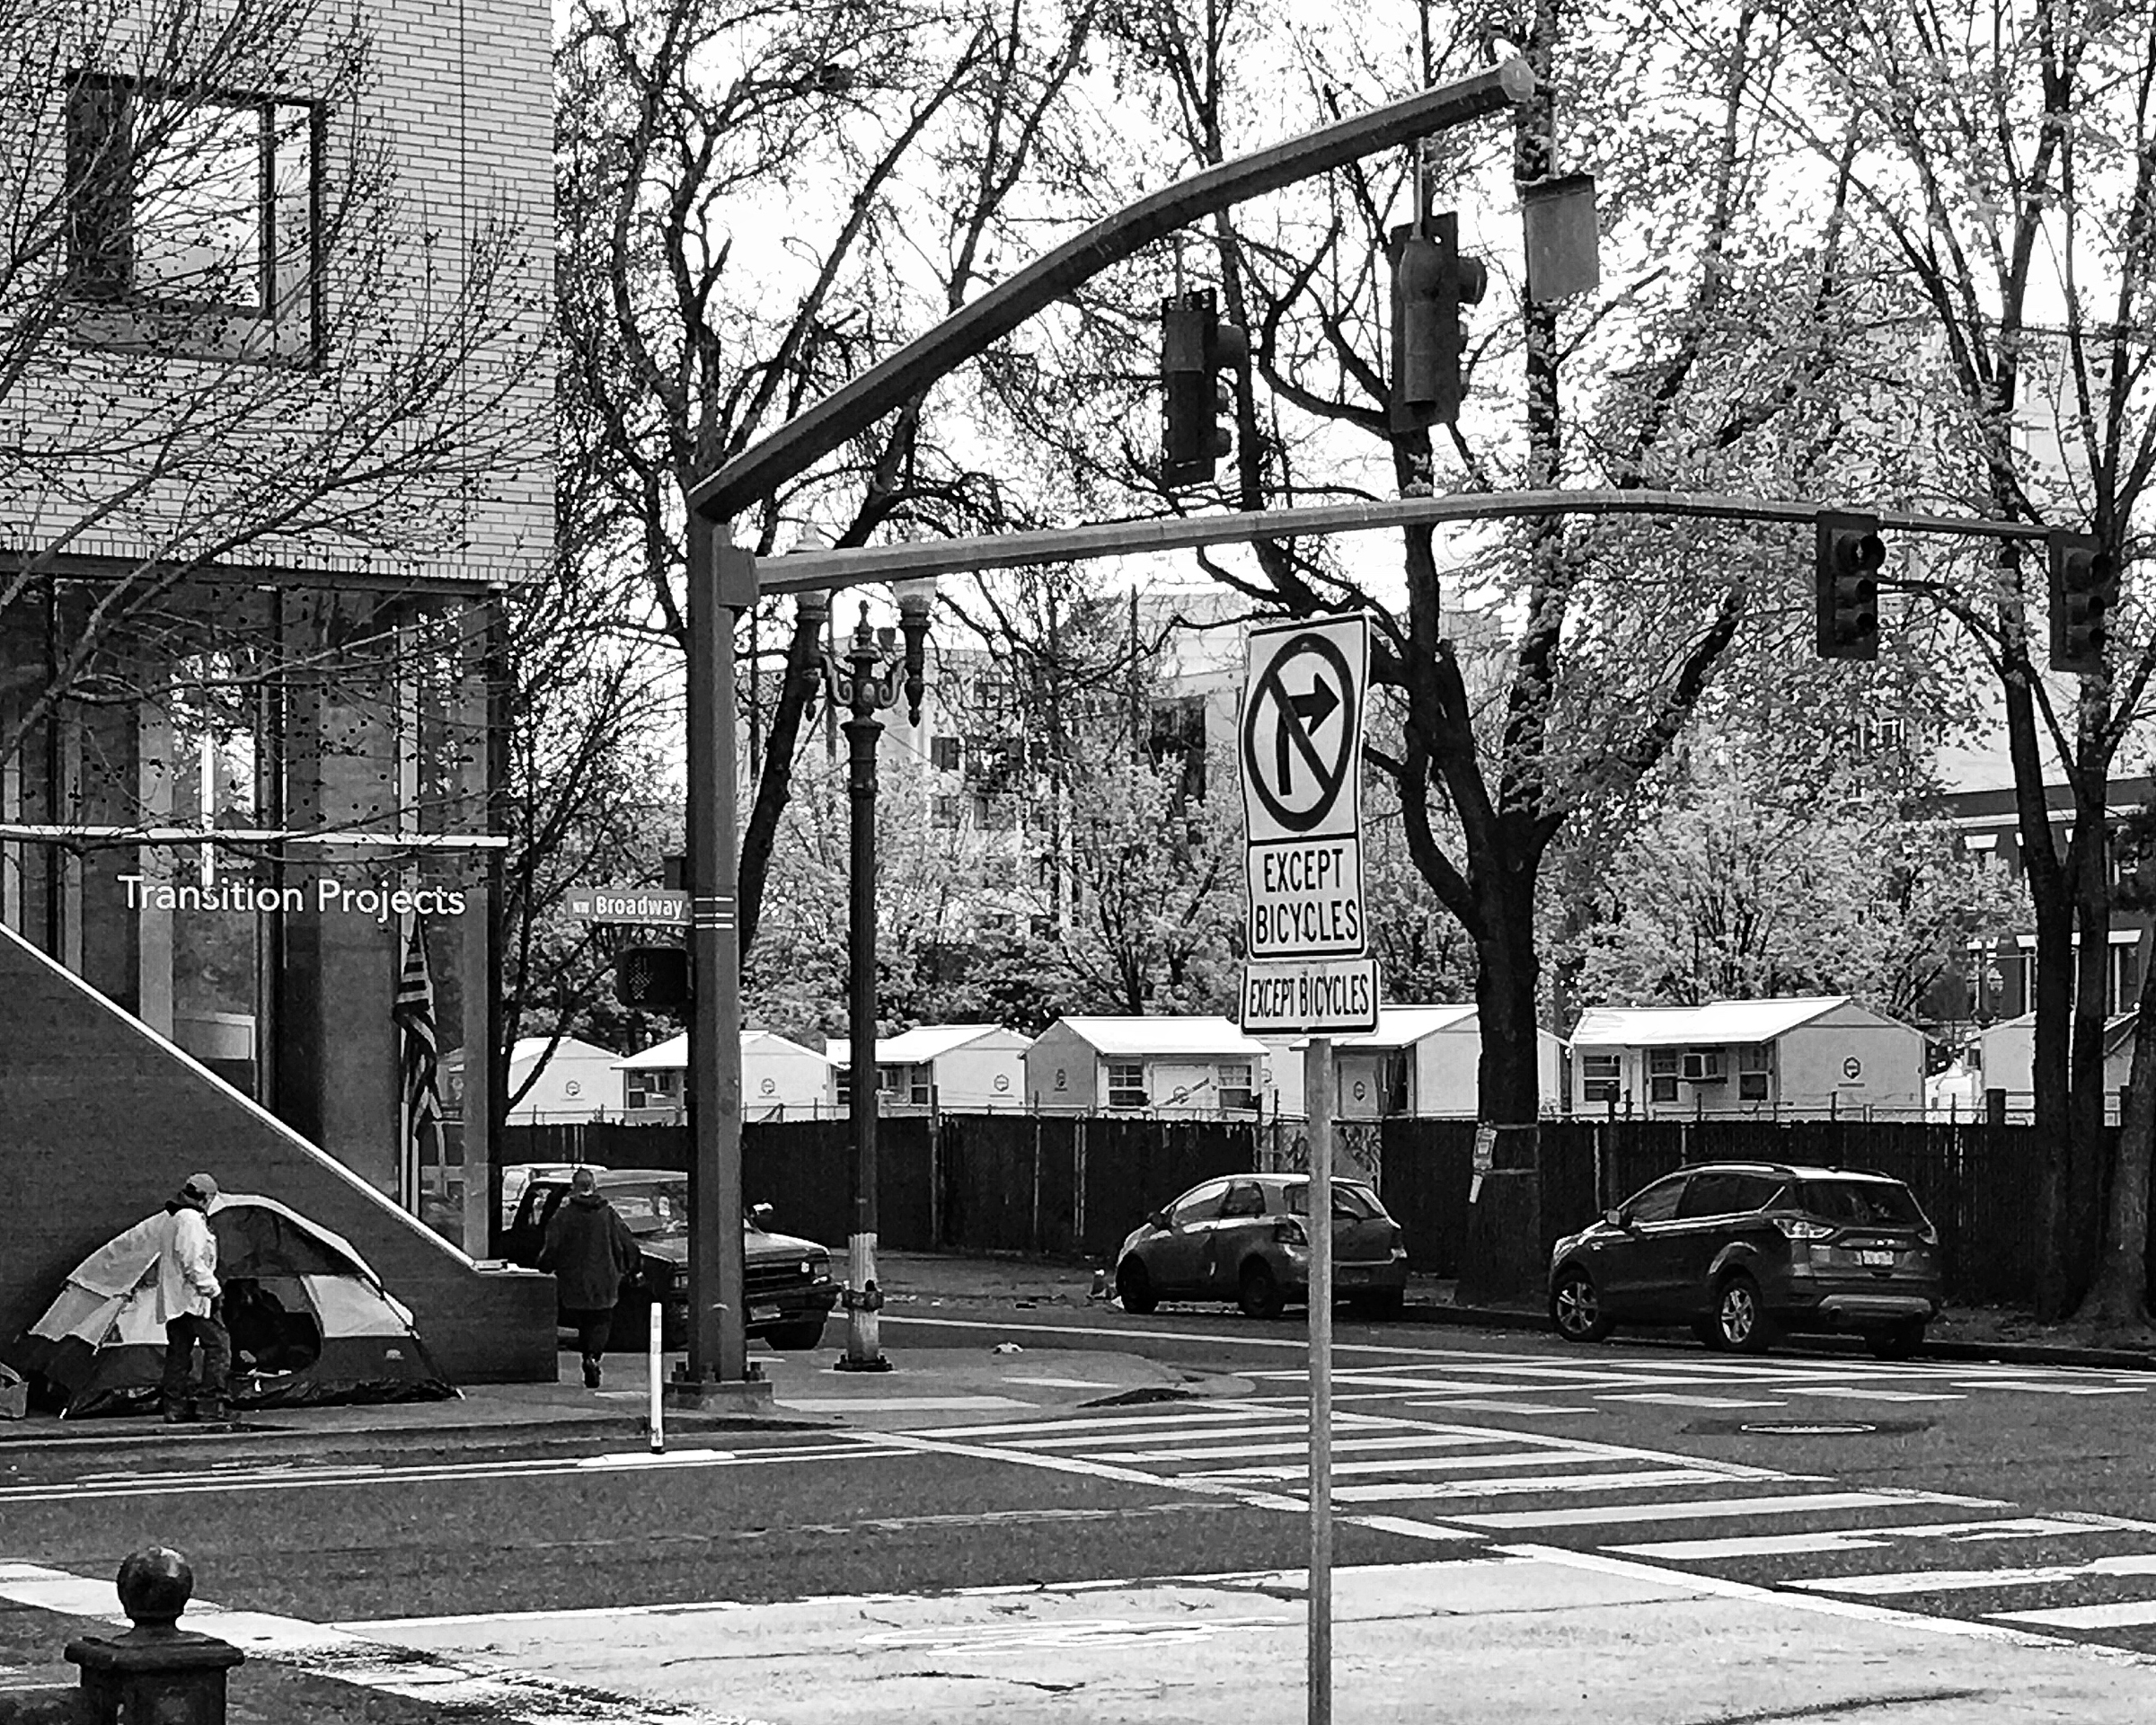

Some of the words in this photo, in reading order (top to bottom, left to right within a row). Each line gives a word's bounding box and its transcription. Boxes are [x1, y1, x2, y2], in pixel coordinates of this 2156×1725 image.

[1264, 848, 1344, 893] EXCEPT
[117, 874, 304, 911] Transition
[317, 878, 466, 924] Projects
[596, 895, 683, 921] Broadway
[1257, 898, 1358, 945] BICYCLES
[1249, 978, 1295, 1018] EXCEPT
[1299, 974, 1369, 1018] BICYCLES
